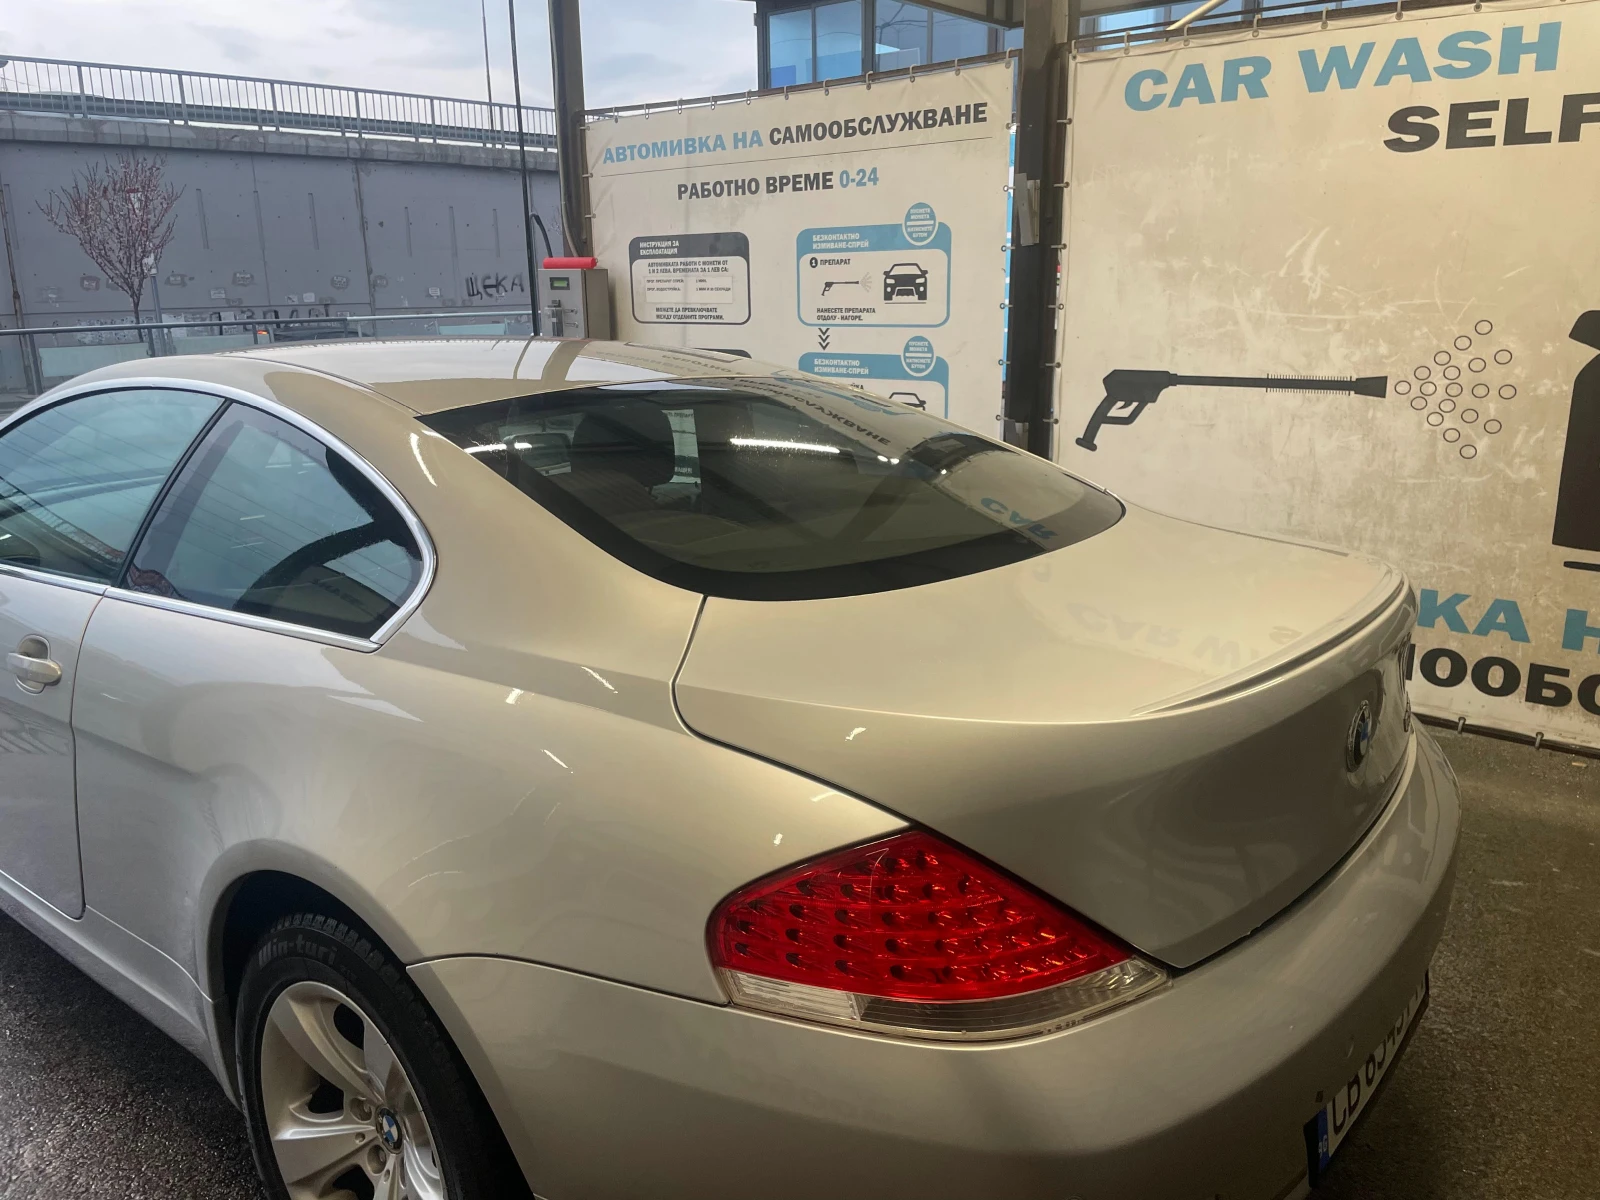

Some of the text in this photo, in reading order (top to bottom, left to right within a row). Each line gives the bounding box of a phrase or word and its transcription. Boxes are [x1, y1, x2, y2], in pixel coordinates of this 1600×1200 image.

[1124, 21, 1562, 111] CAR WASH
[603, 102, 988, 164] АВТОМИВКА НА САМООБСЛУЖВАНЕ
[1383, 91, 1600, 153] SELF
[678, 167, 879, 200] РАБОТНО ВРЕМЕ 0-24
[813, 240, 869, 249] ИЗМИВАНЕ-СПРЕЙ
[814, 366, 869, 374] ИЗМИВАНЕ-СПРЕЙ
[1405, 643, 1600, 716] ООБ
